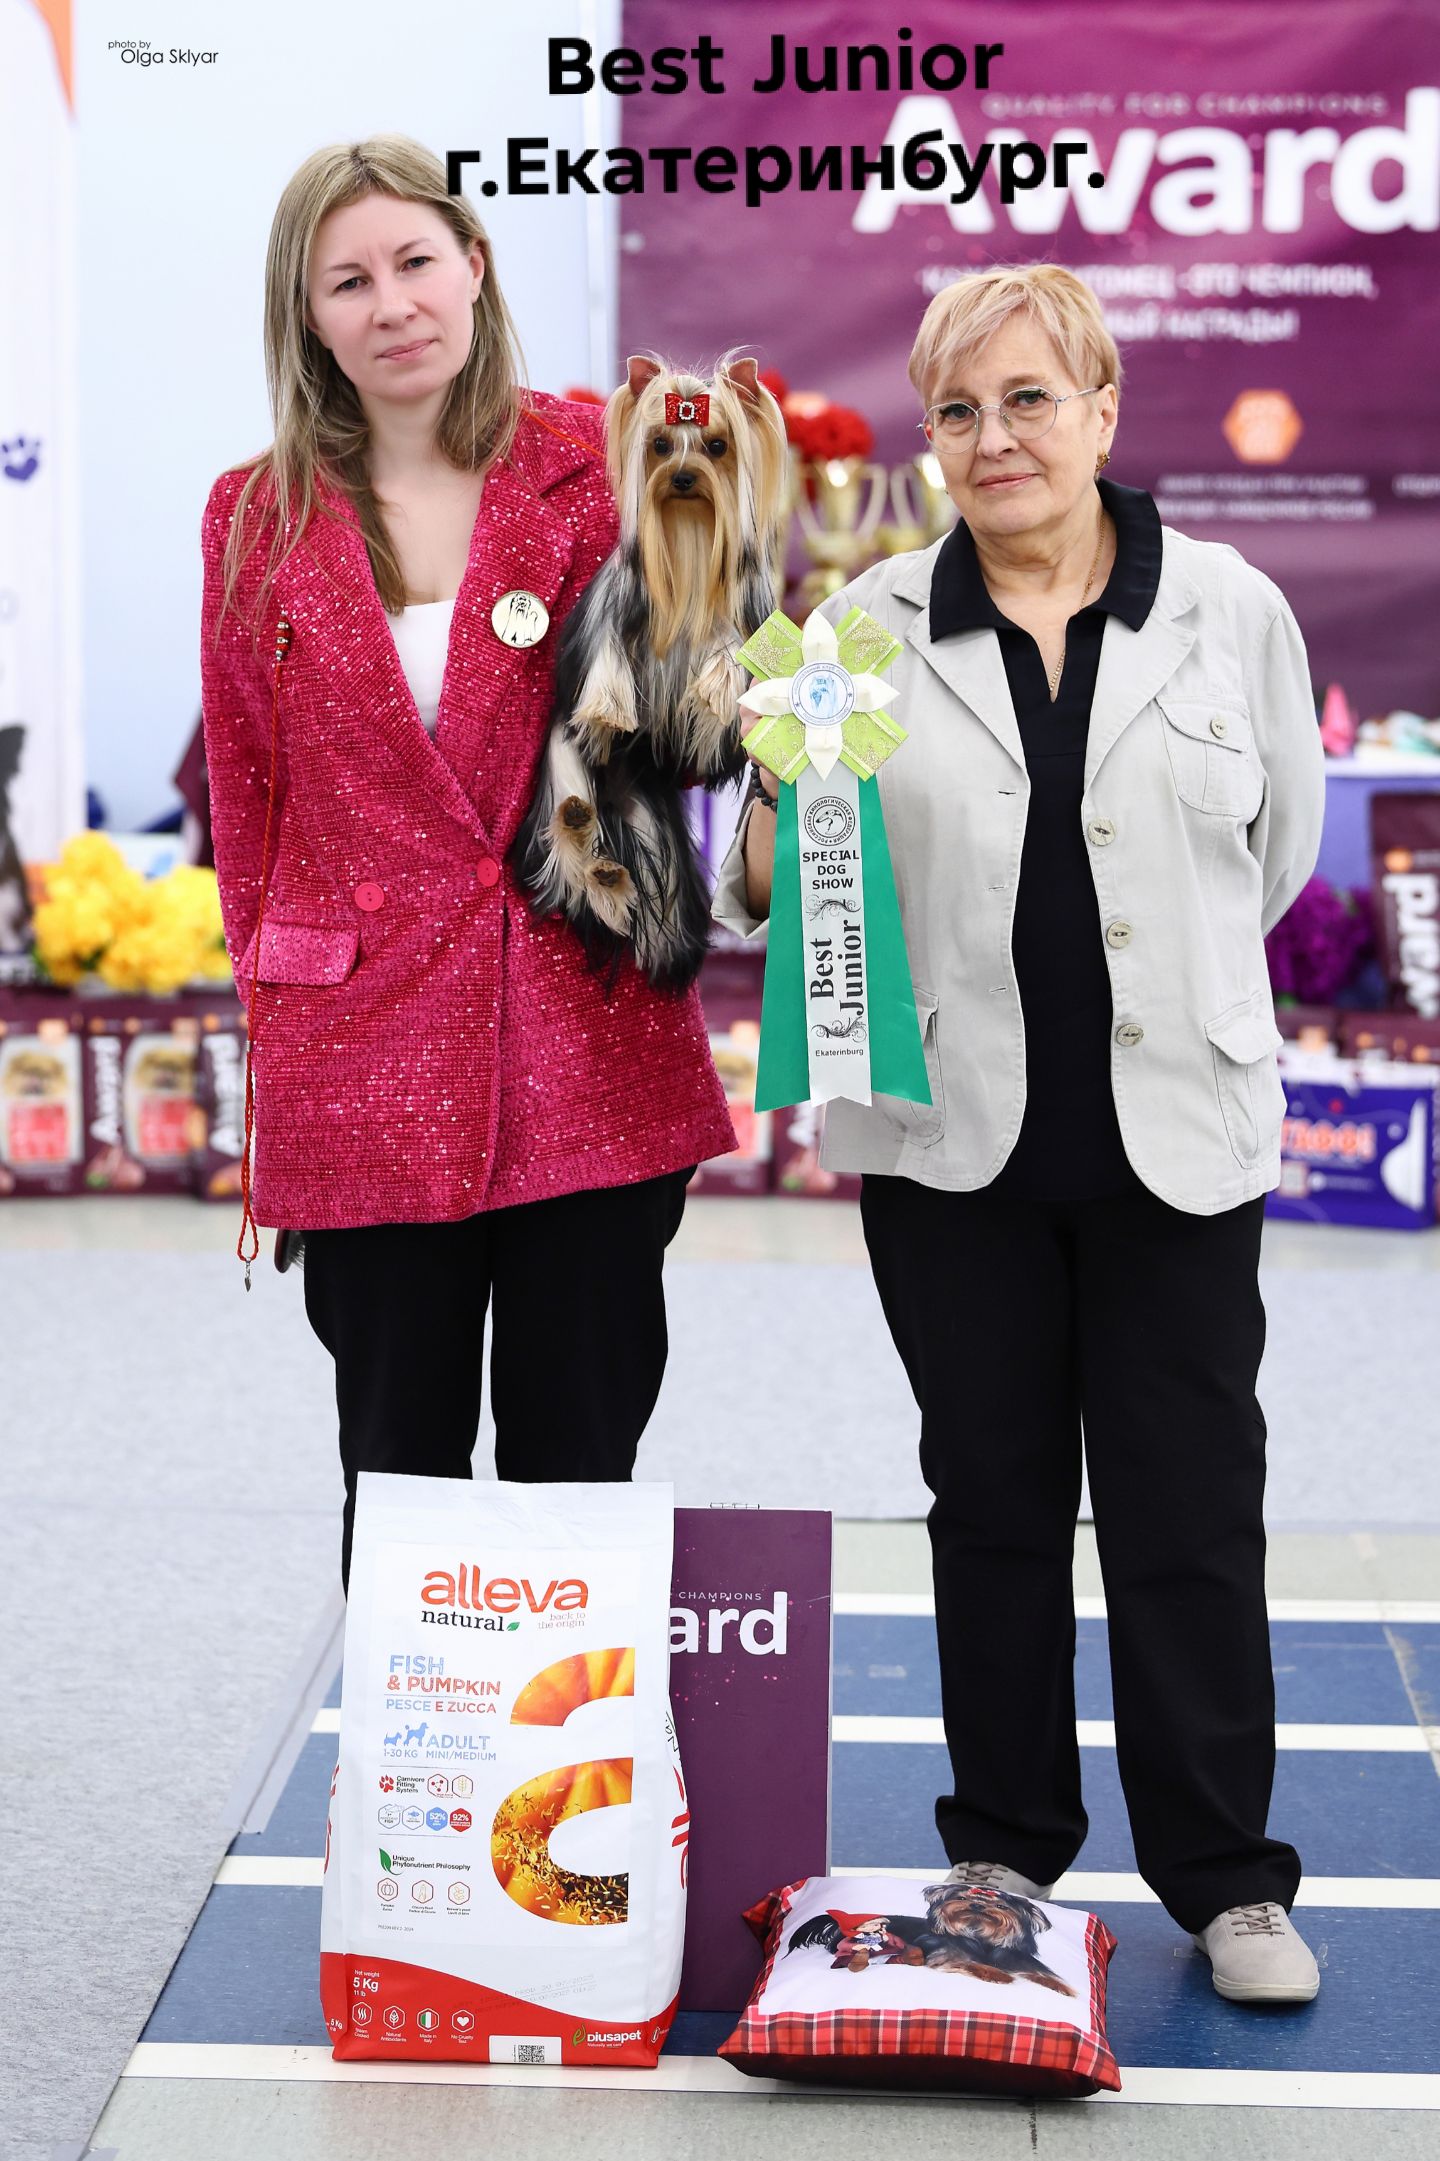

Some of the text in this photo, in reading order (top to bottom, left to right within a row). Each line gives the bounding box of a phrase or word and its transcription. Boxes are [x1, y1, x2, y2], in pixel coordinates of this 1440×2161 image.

[851, 86, 1440, 236] Award
[802, 849, 860, 863] SPECIAL
[817, 864, 846, 876] DOG
[812, 877, 854, 890] SHOW
[810, 937, 834, 1001] Best
[837, 919, 865, 1016] Junior
[815, 1048, 864, 1057] Ekaterinburg
[421, 1562, 589, 1613] alleva
[678, 1591, 762, 1601] CHAMPIONS
[421, 1609, 505, 1631] natural
[550, 1611, 586, 1621] back to
[538, 1620, 585, 1630] the origin
[389, 1655, 445, 1675] FISH
[387, 1675, 501, 1696] & PUMPKIN
[386, 1699, 497, 1714] PESCE E ZUCCA
[426, 1734, 491, 1751] ADULT
[383, 1748, 497, 1761] 1-30 KG MINI/MEDIUM
[396, 1775, 425, 1783] Carnivore
[392, 1854, 415, 1862] Unique
[392, 1861, 471, 1871] Phytonutrient Philosophy
[353, 1976, 379, 1993] 5 Kg
